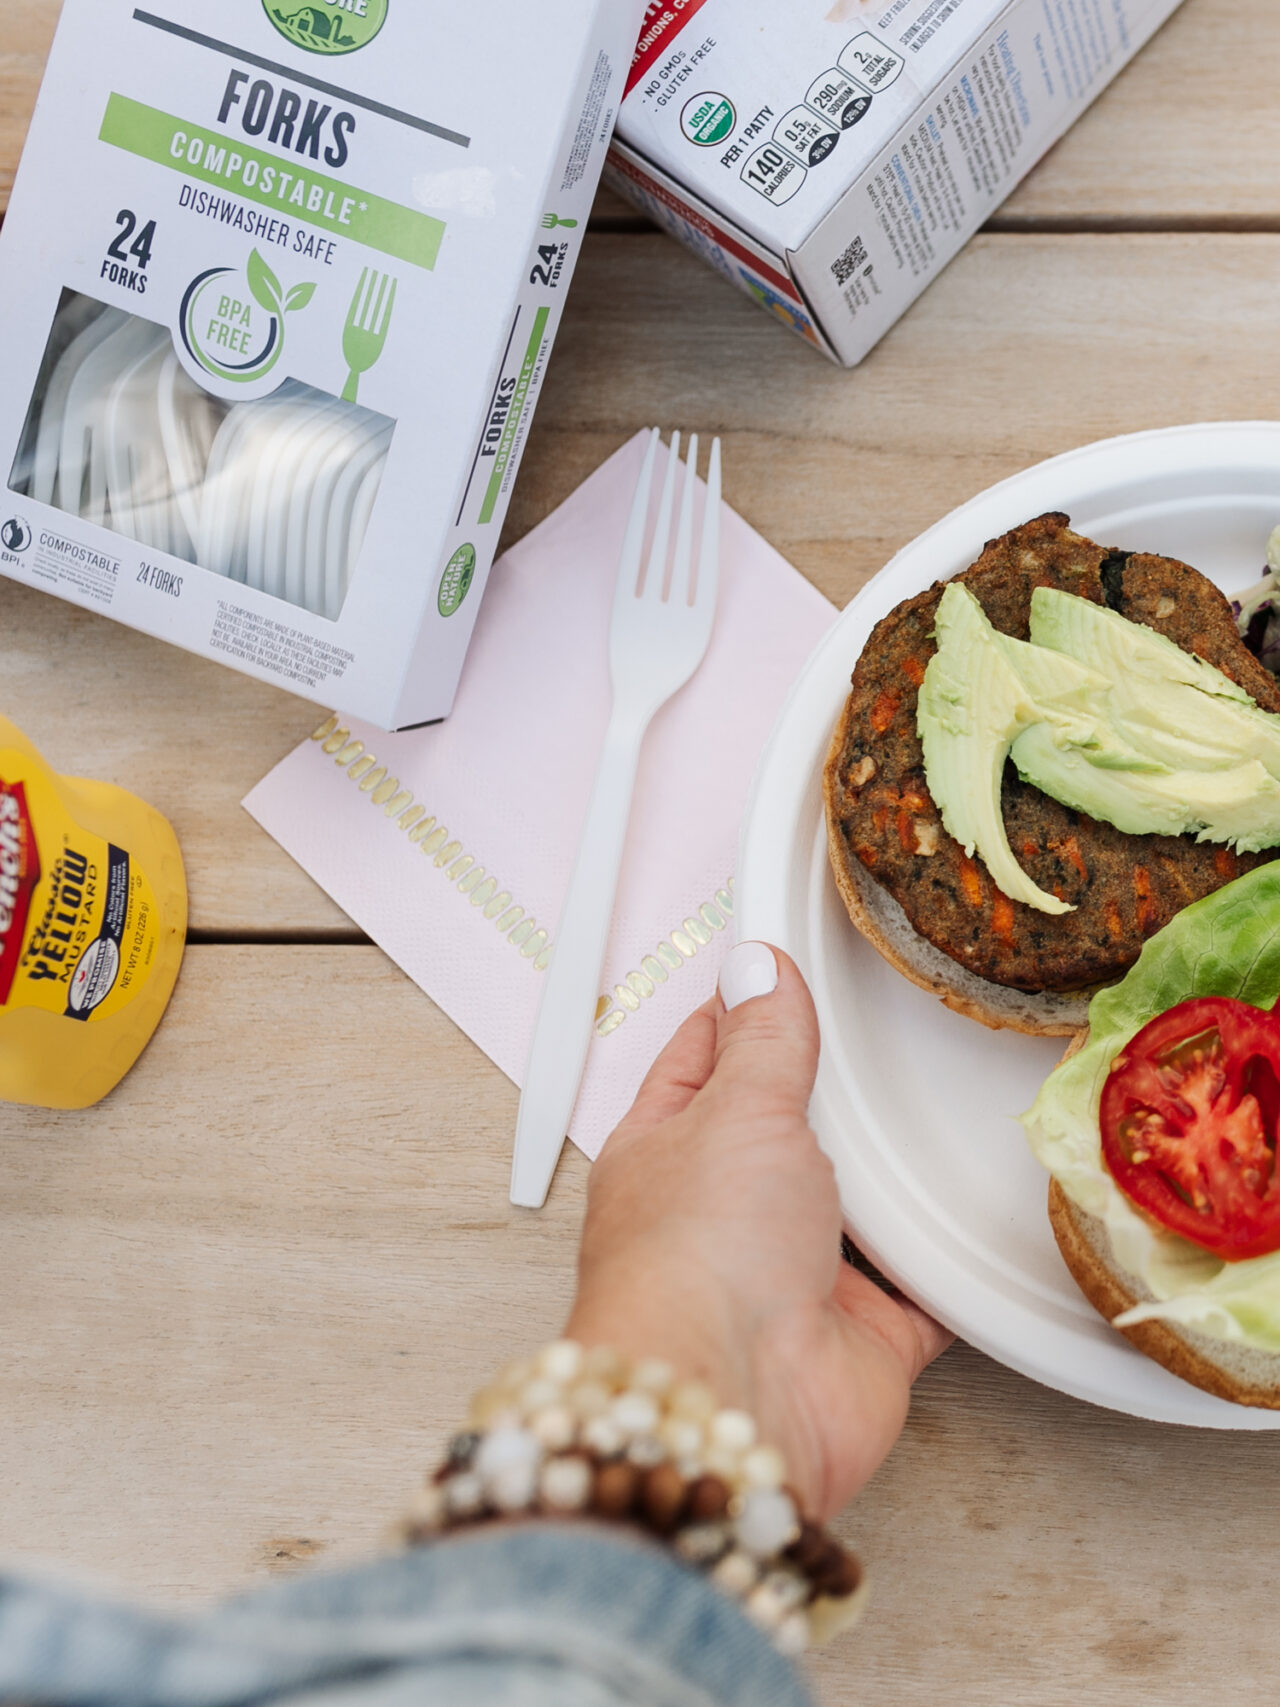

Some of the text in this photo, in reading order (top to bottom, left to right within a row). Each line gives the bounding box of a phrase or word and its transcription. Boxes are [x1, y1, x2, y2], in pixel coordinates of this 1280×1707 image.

[637, 10, 679, 52] ONIONS,
[877, 12, 893, 29] KEEP
[899, 22, 922, 46] SERVING
[909, 25, 936, 54] ENLARGED
[929, 19, 942, 29] TO
[936, 5, 954, 23] SHOW
[644, 50, 687, 98] NO GMOs
[656, 37, 717, 107] GLUTEN FREE
[861, 54, 886, 76] TOTAL
[868, 57, 897, 87] SUGARS
[216, 68, 356, 169] FORKS
[688, 100, 716, 129] USDA
[826, 86, 856, 116] SODIUM
[843, 98, 867, 124] 12% DV
[698, 105, 729, 141] ORGANIC
[719, 105, 775, 169] PER 1 PATTY
[794, 123, 822, 153] SAT FAT
[748, 148, 784, 185] 140
[811, 136, 833, 160] 3% DV
[763, 160, 796, 197] CALORIES
[106, 209, 157, 270] 24
[178, 184, 337, 265] DISHWASHER SAFE
[100, 259, 148, 294] FORKS
[529, 243, 559, 286] 24
[549, 242, 569, 288] FORKS
[216, 294, 251, 328] BPA
[206, 319, 252, 355] FREE
[480, 377, 517, 457] FORKS
[501, 426, 525, 493] DISHWASHER
[531, 365, 542, 385] BPA
[537, 339, 549, 363] FREE
[0, 551, 20, 566] BPI
[39, 532, 120, 575] COMPOSTABLE
[83, 564, 117, 583] FACILITIES
[136, 561, 151, 584] 24
[149, 566, 184, 598] FORKS
[440, 563, 457, 601] OPEN
[445, 555, 466, 607] NATURE
[229, 604, 263, 625] COMPONENTS
[242, 620, 279, 642] COMPOSTABLE
[28, 848, 88, 981] YELLOW
[59, 864, 98, 983] MUSTARD
[120, 901, 150, 990] NET WT 8 OZ (226 g)
[80, 989, 92, 1009] WE
[87, 938, 109, 989] PROMISE
